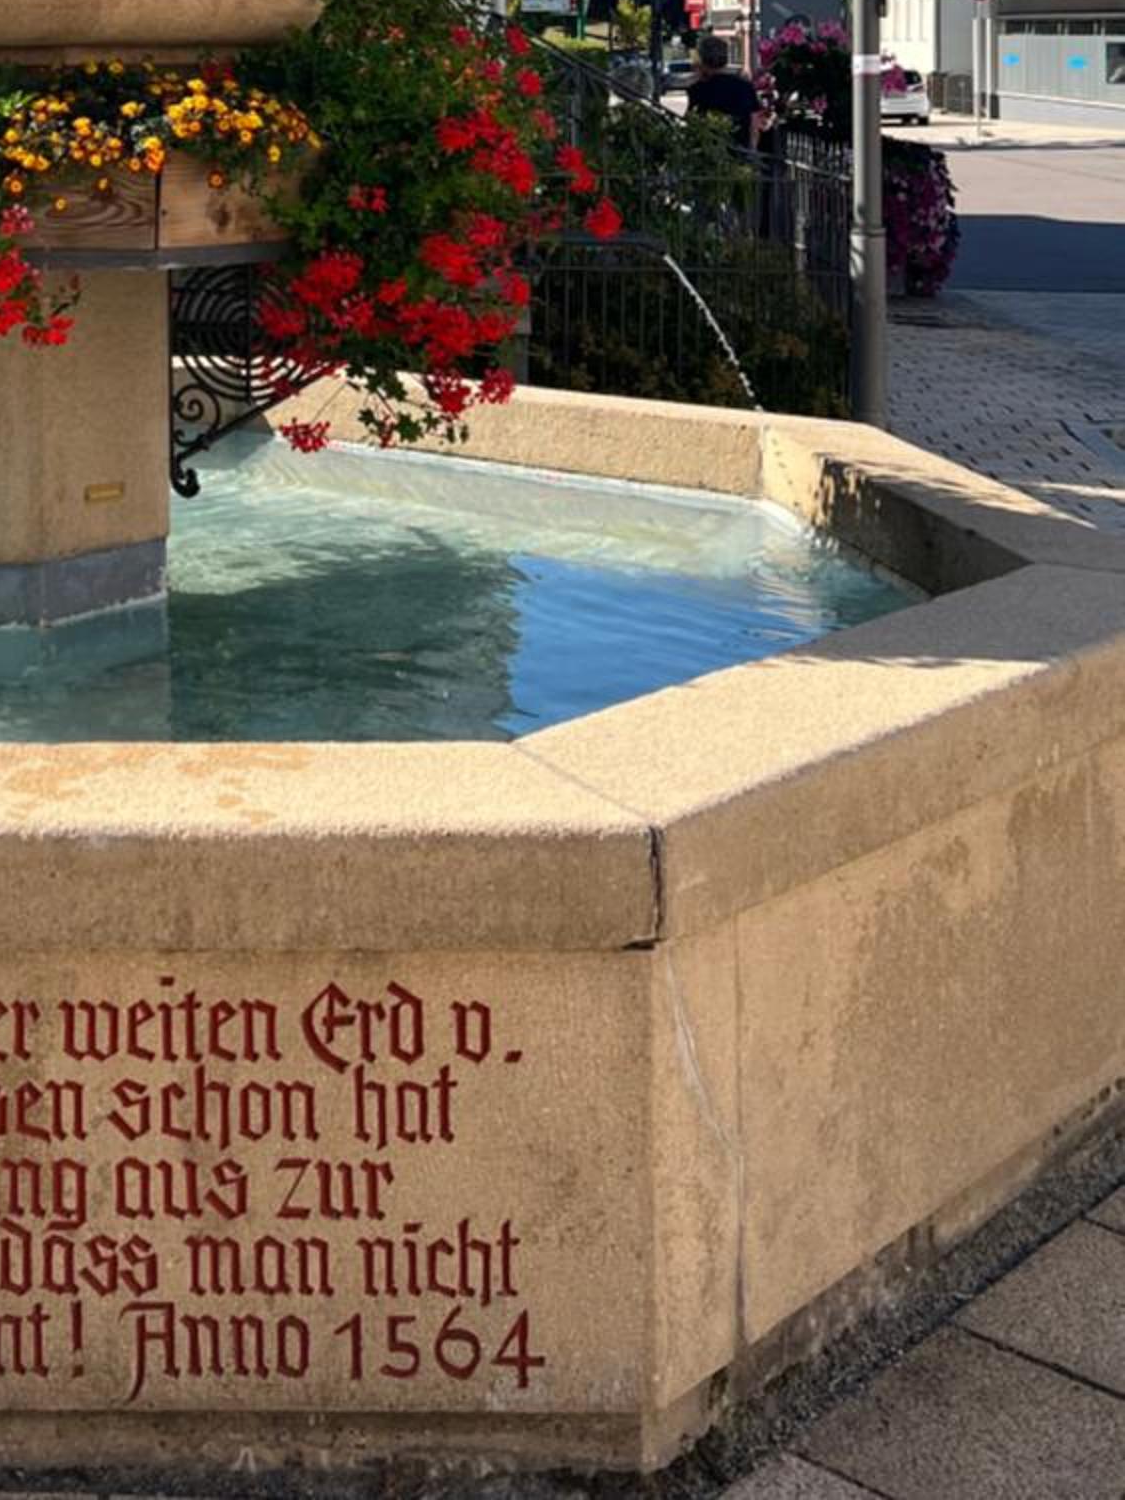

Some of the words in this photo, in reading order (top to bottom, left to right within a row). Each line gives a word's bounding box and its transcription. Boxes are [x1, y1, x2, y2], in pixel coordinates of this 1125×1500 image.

[59, 976, 281, 1062] weiten
[301, 981, 423, 1074] Erd
[107, 1063, 318, 1151] schon
[353, 1063, 457, 1151] hat
[115, 1156, 247, 1220] aus
[276, 1156, 394, 1221] zur
[0, 1217, 157, 1298] dass
[185, 1235, 333, 1297] man
[357, 1219, 519, 1307] nicht
[122, 1301, 309, 1400] Anno
[334, 1306, 544, 1389] 1564
